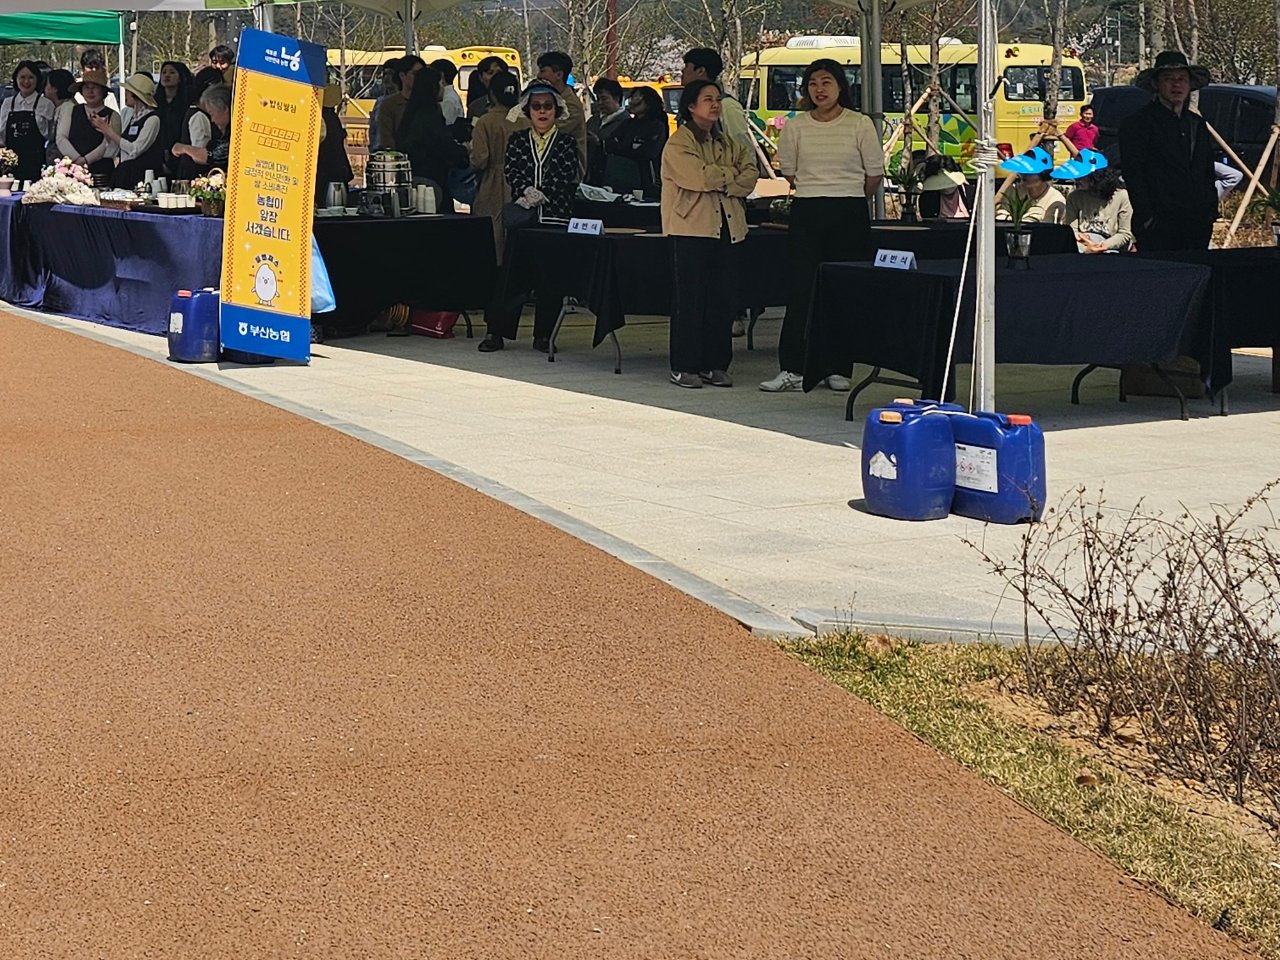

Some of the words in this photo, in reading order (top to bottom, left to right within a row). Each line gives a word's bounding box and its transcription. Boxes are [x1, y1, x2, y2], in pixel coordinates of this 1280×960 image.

[256, 193, 284, 209] 농협이
[259, 209, 278, 224] 앞장
[249, 324, 291, 343] 부산농협
